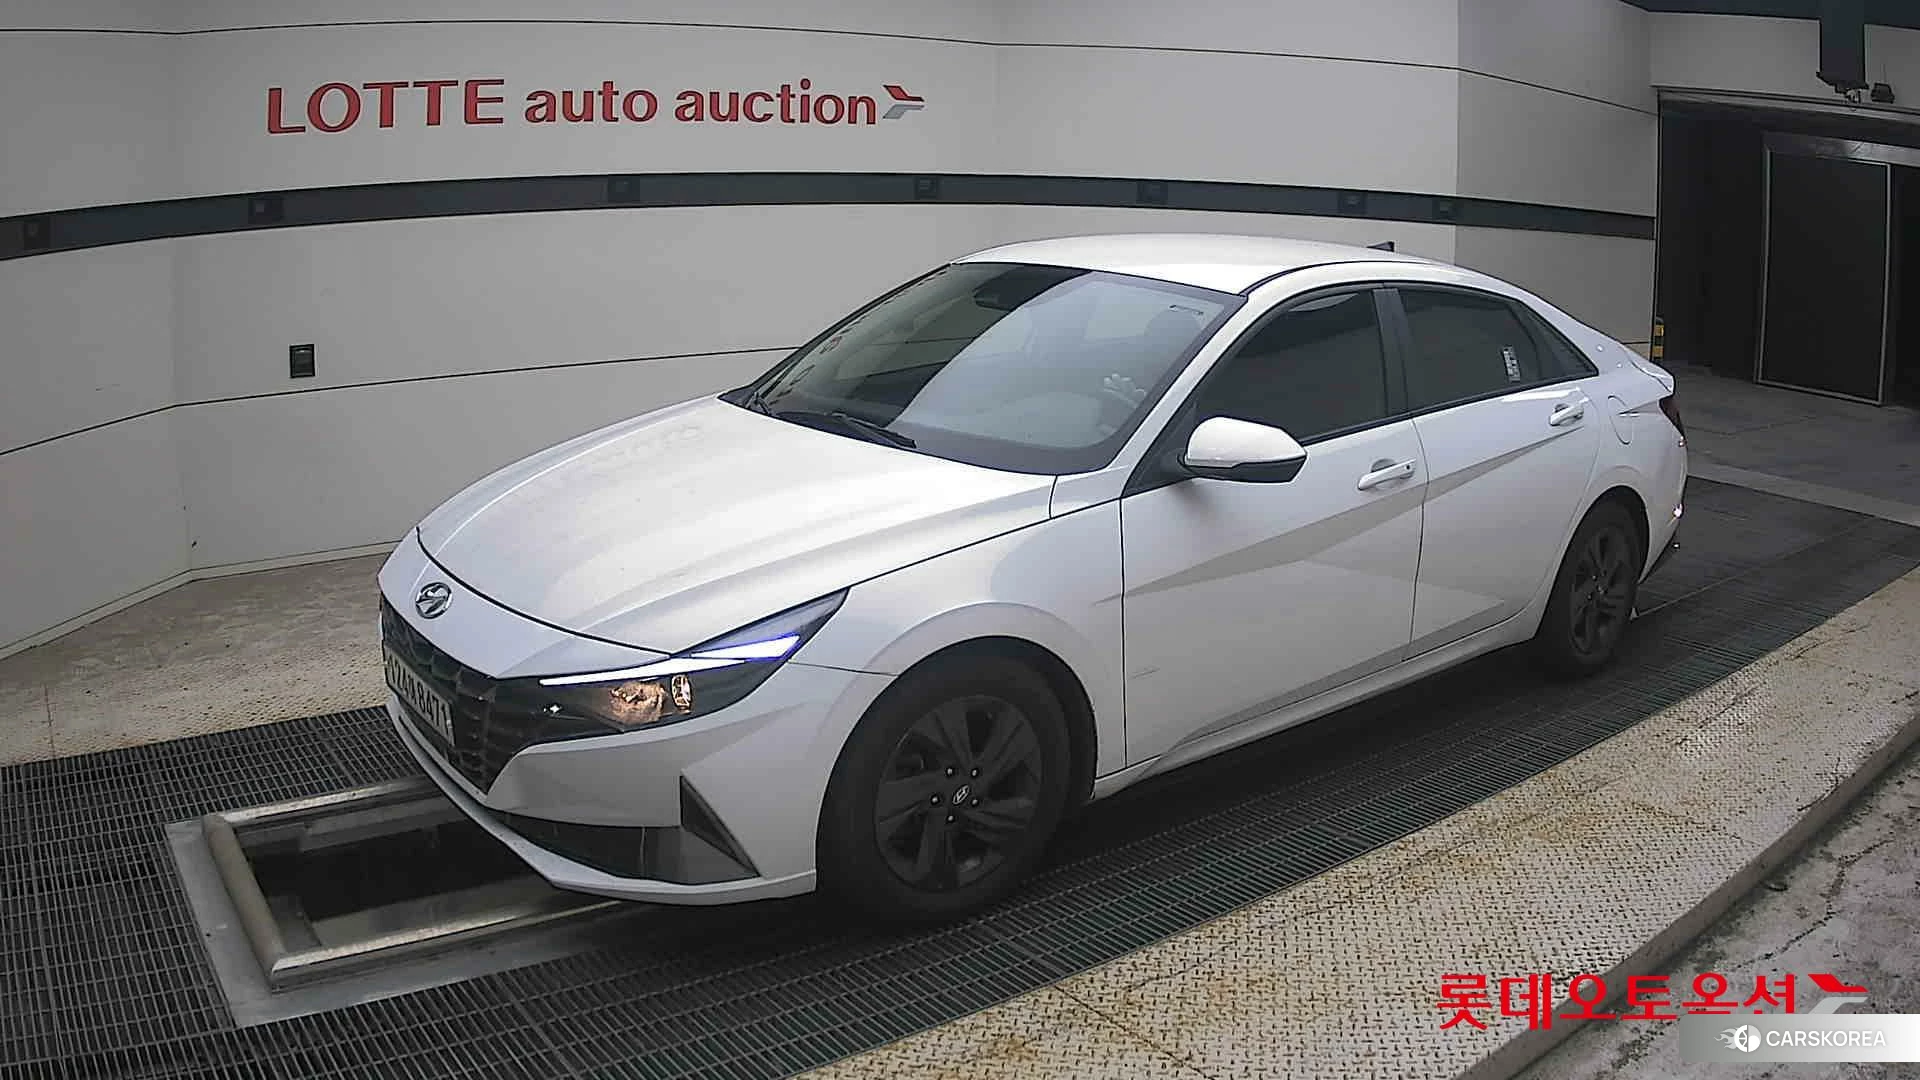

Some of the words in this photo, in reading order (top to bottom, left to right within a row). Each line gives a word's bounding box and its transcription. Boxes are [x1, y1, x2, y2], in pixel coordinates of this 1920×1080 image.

[267, 79, 504, 134] LOTTE
[525, 80, 658, 123] auto
[674, 78, 876, 125] auction
